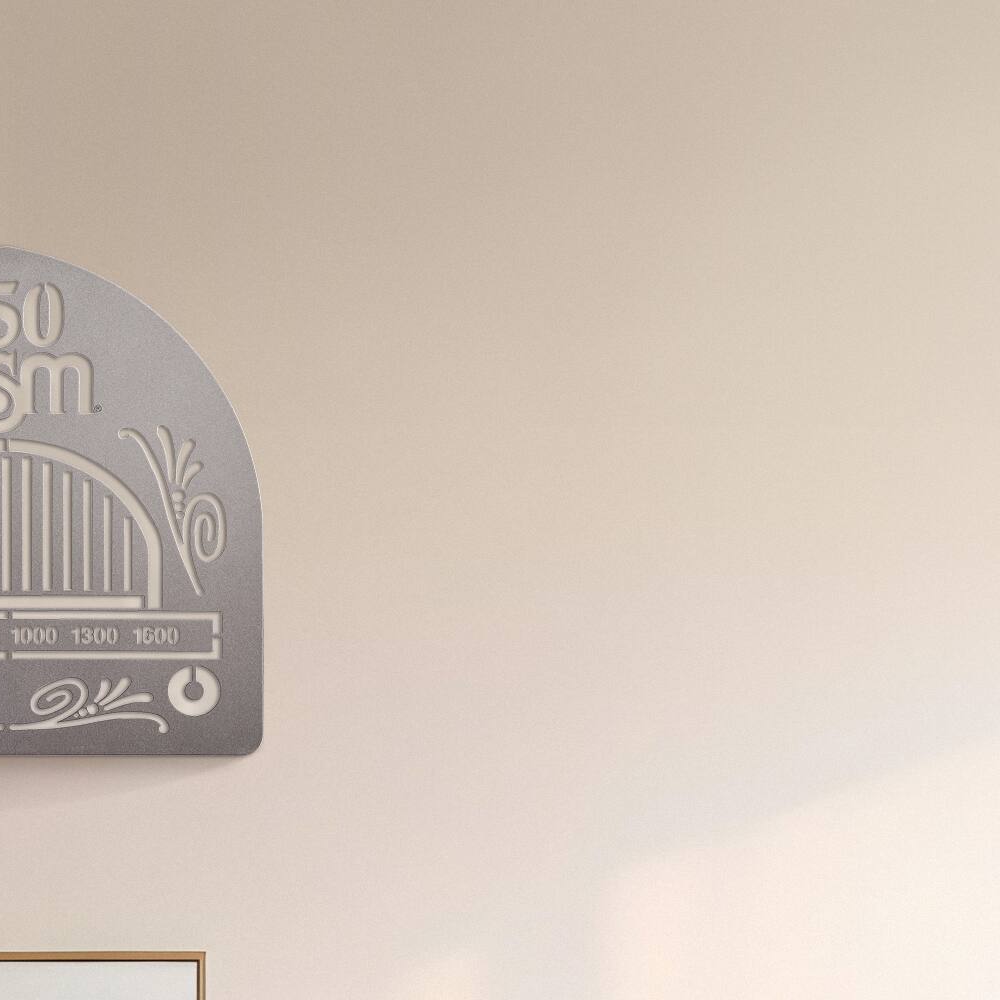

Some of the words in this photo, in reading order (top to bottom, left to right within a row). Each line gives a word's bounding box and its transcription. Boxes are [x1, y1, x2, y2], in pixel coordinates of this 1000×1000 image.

[11, 625, 58, 645] 1000
[71, 625, 119, 645] 1300
[133, 625, 179, 645] 1600
